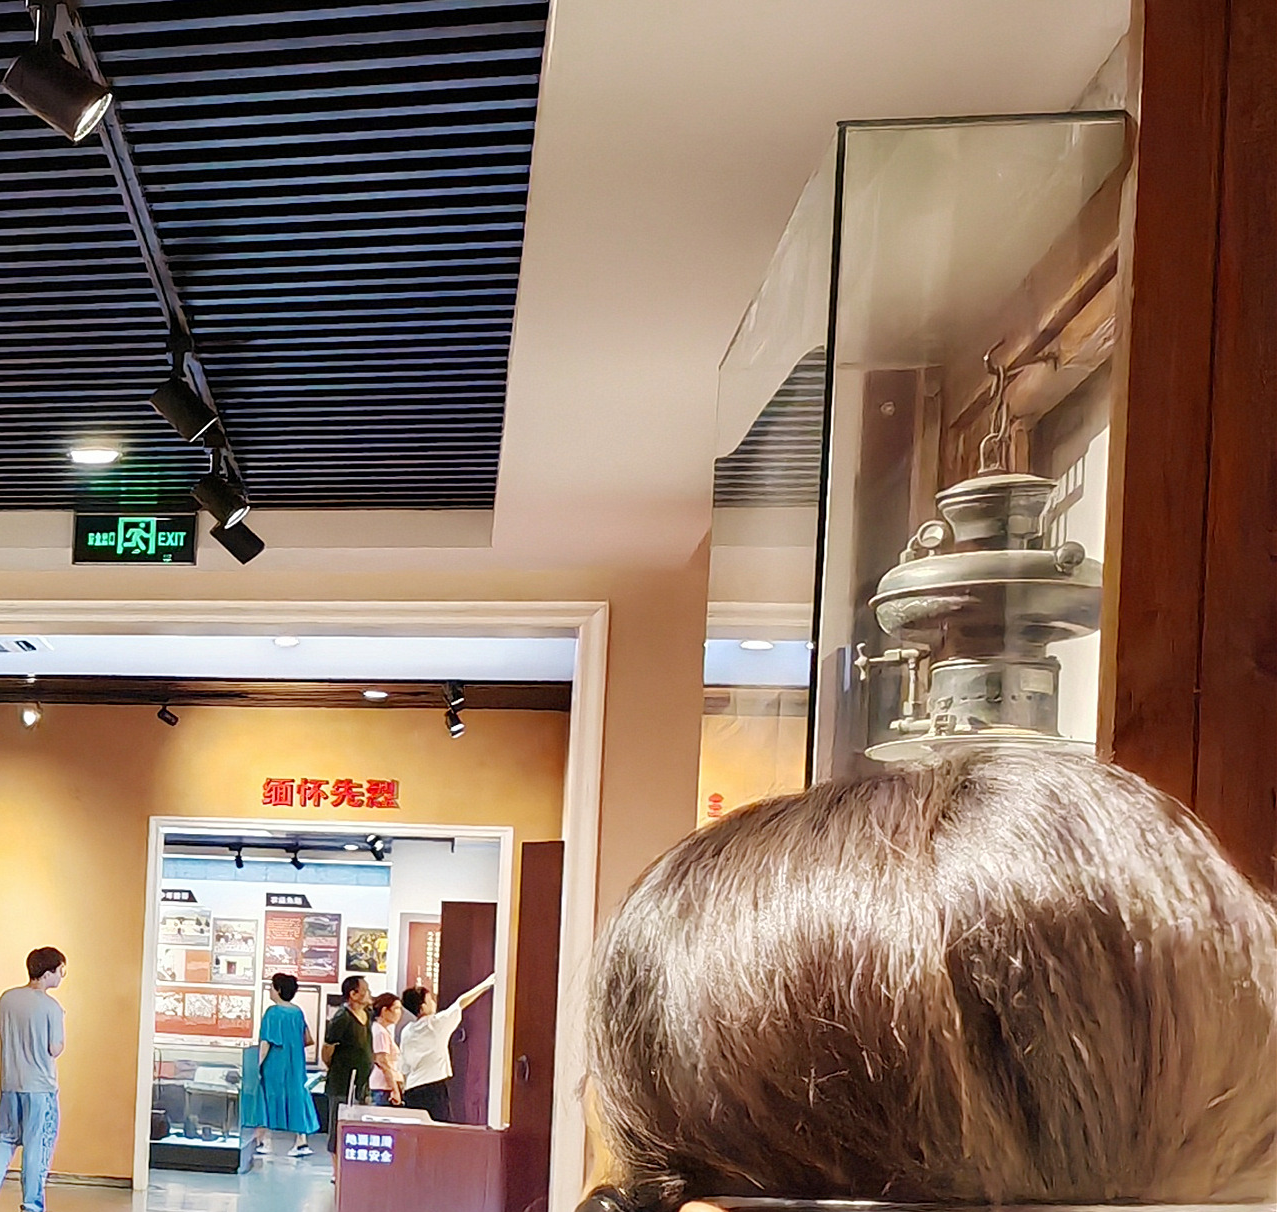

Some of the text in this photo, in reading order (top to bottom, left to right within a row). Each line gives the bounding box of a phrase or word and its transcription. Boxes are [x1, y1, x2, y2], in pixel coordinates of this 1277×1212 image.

[158, 532, 187, 546] EXIT
[262, 777, 401, 809] 缅怀先烈
